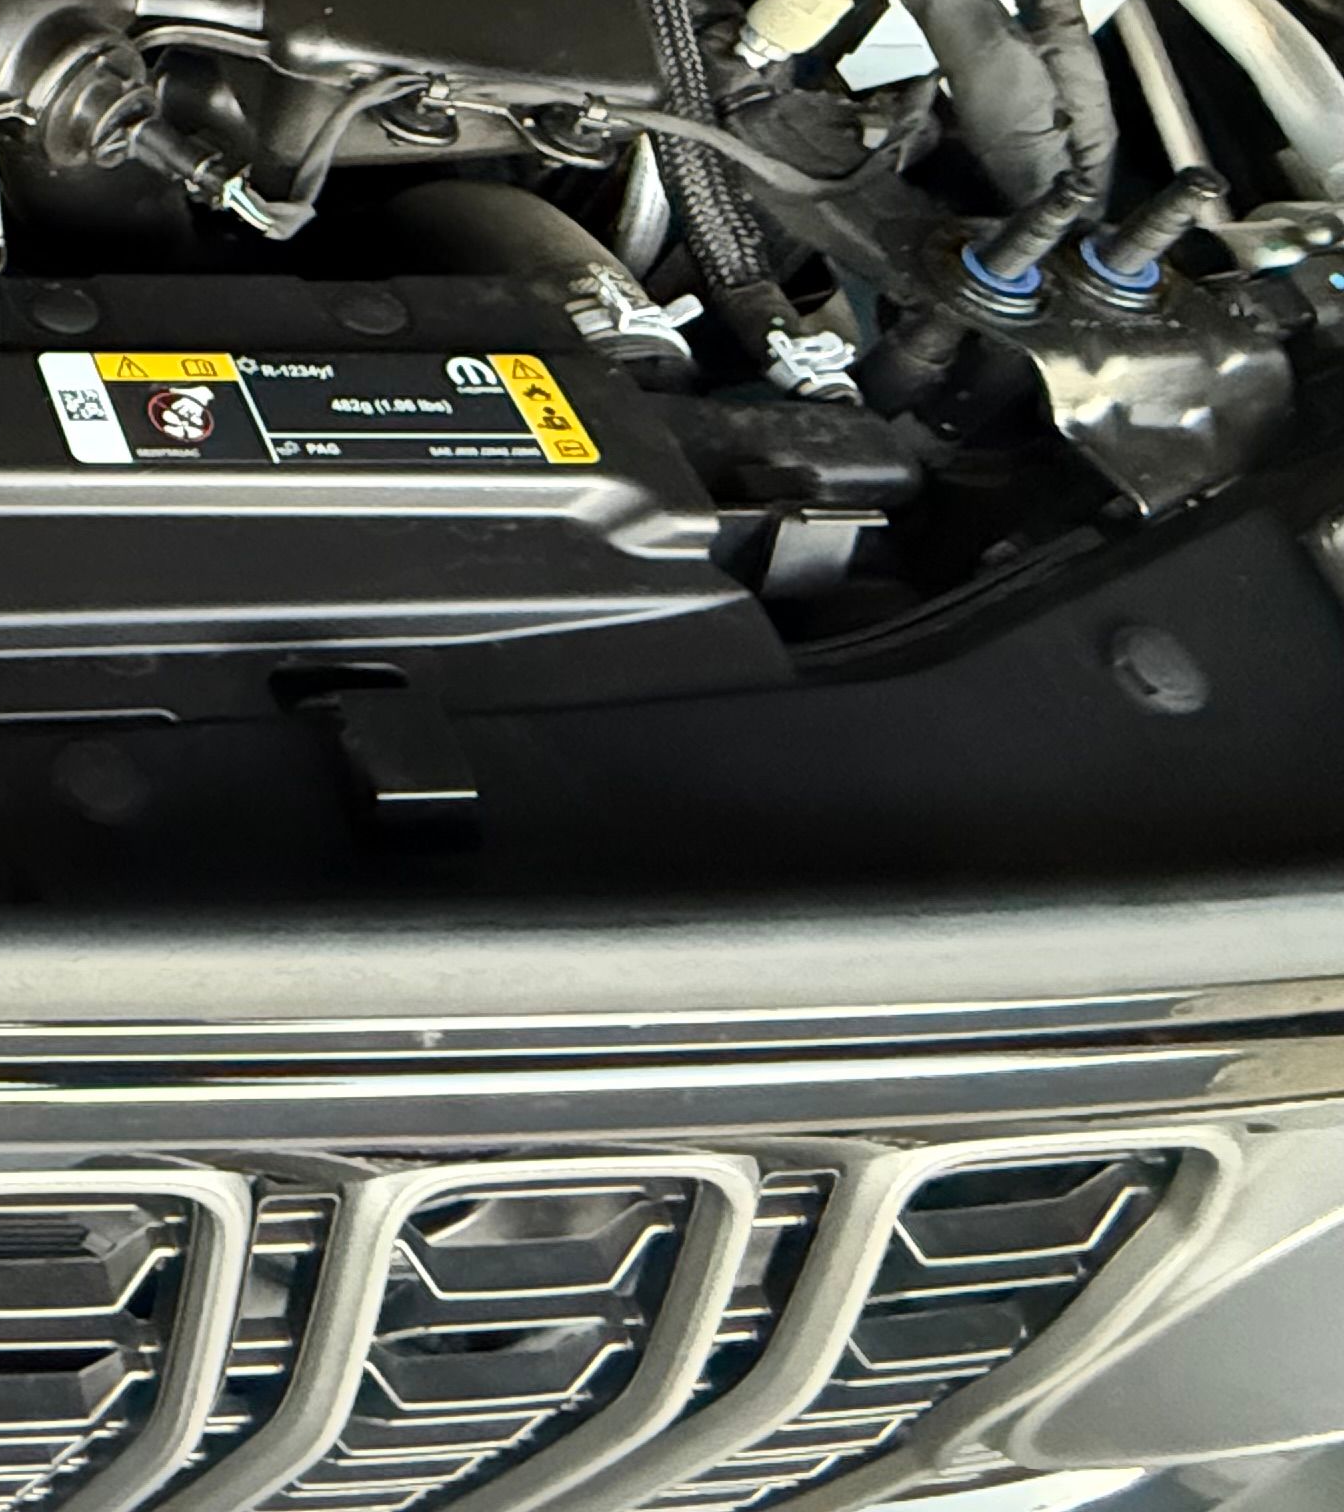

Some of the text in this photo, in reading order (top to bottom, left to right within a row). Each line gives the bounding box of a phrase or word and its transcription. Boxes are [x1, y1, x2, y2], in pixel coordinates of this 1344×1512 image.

[260, 363, 335, 381] R-1234yf
[417, 398, 454, 415] lbs)
[306, 442, 342, 456] PAG
